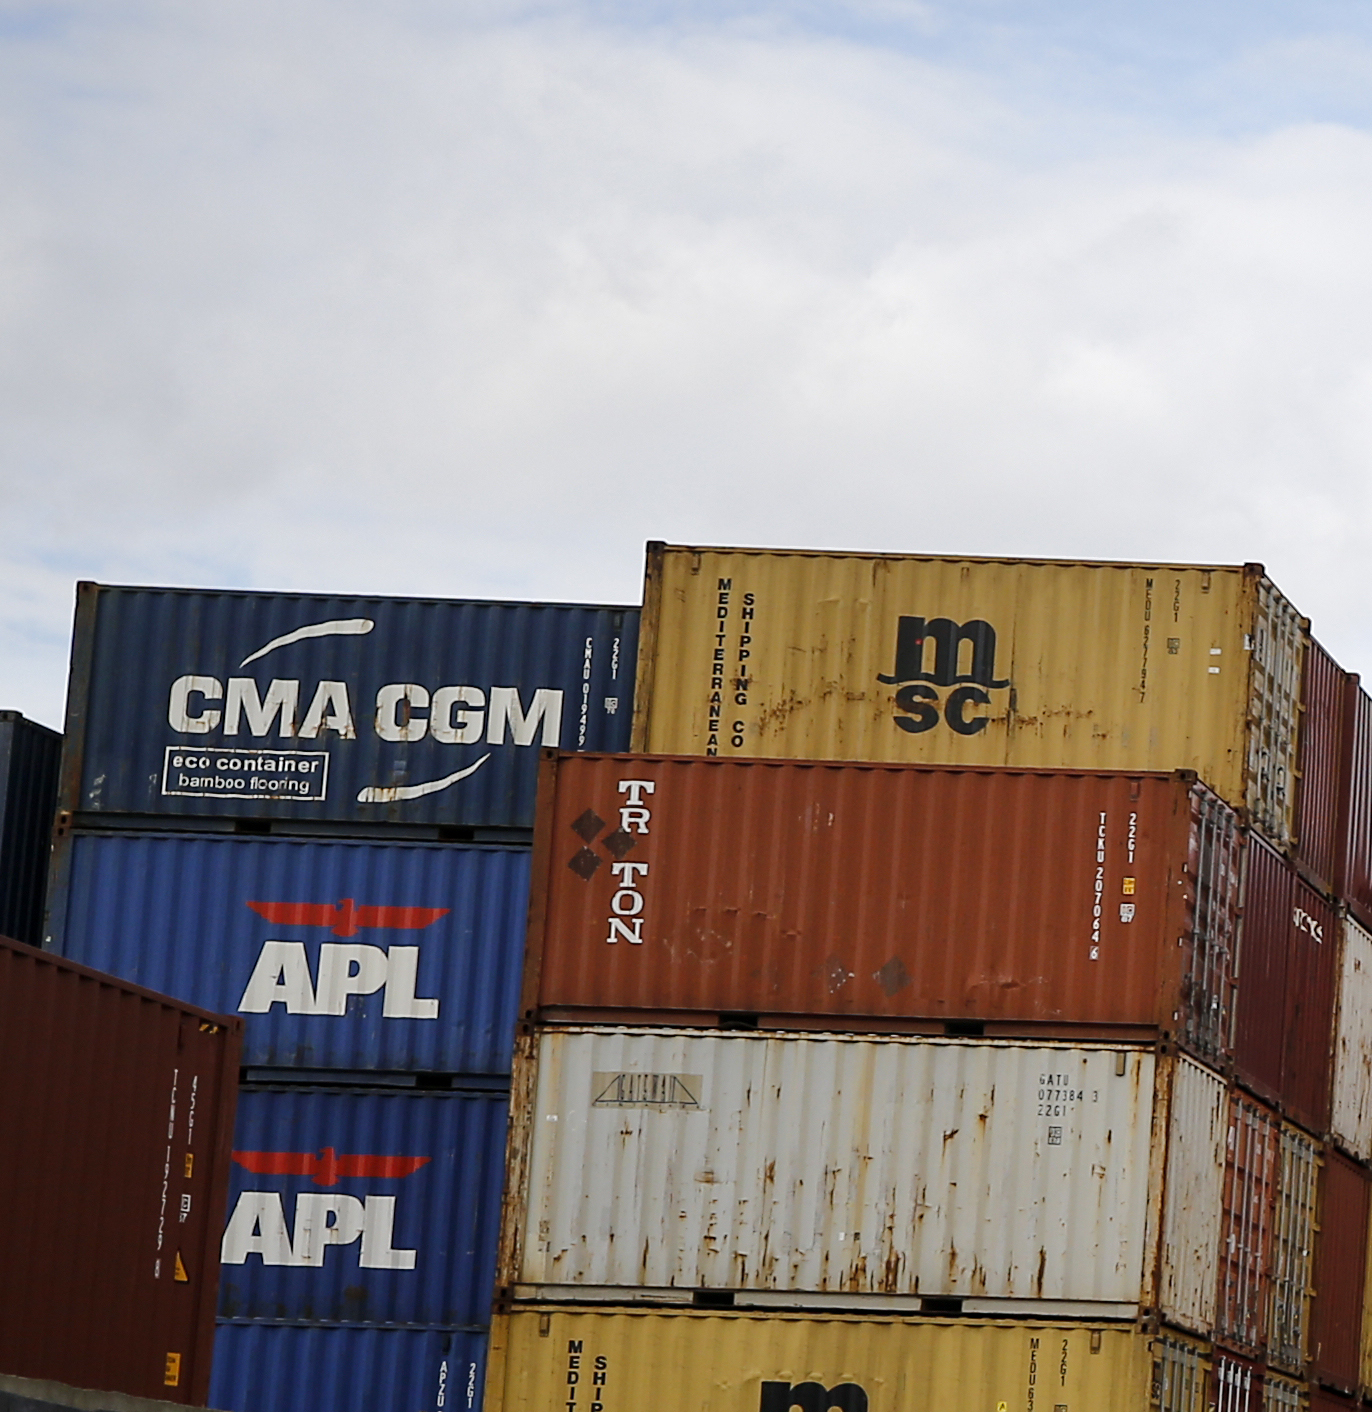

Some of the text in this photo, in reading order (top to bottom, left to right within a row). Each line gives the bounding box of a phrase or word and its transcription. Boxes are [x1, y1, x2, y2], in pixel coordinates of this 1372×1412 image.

[583, 637, 593, 680] CMAU
[611, 638, 620, 680] 22G1
[732, 593, 755, 748] SHIPPING CO
[168, 674, 563, 748] CMA CGM
[173, 756, 319, 773] eco container
[179, 773, 310, 794] bamboo flooring
[1096, 813, 1107, 863] TCKU
[1128, 813, 1138, 863] 22G1
[1091, 867, 1105, 942] 207064
[238, 941, 438, 1019] APL
[1038, 1089, 1083, 1102] 077384
[1039, 1074, 1069, 1086] GATU
[220, 1191, 416, 1270] APL
[437, 1361, 448, 1407] APZU
[1029, 1338, 1039, 1386] MEDU
[1060, 1339, 1068, 1386] 22G1
[467, 1363, 476, 1409] 22G1
